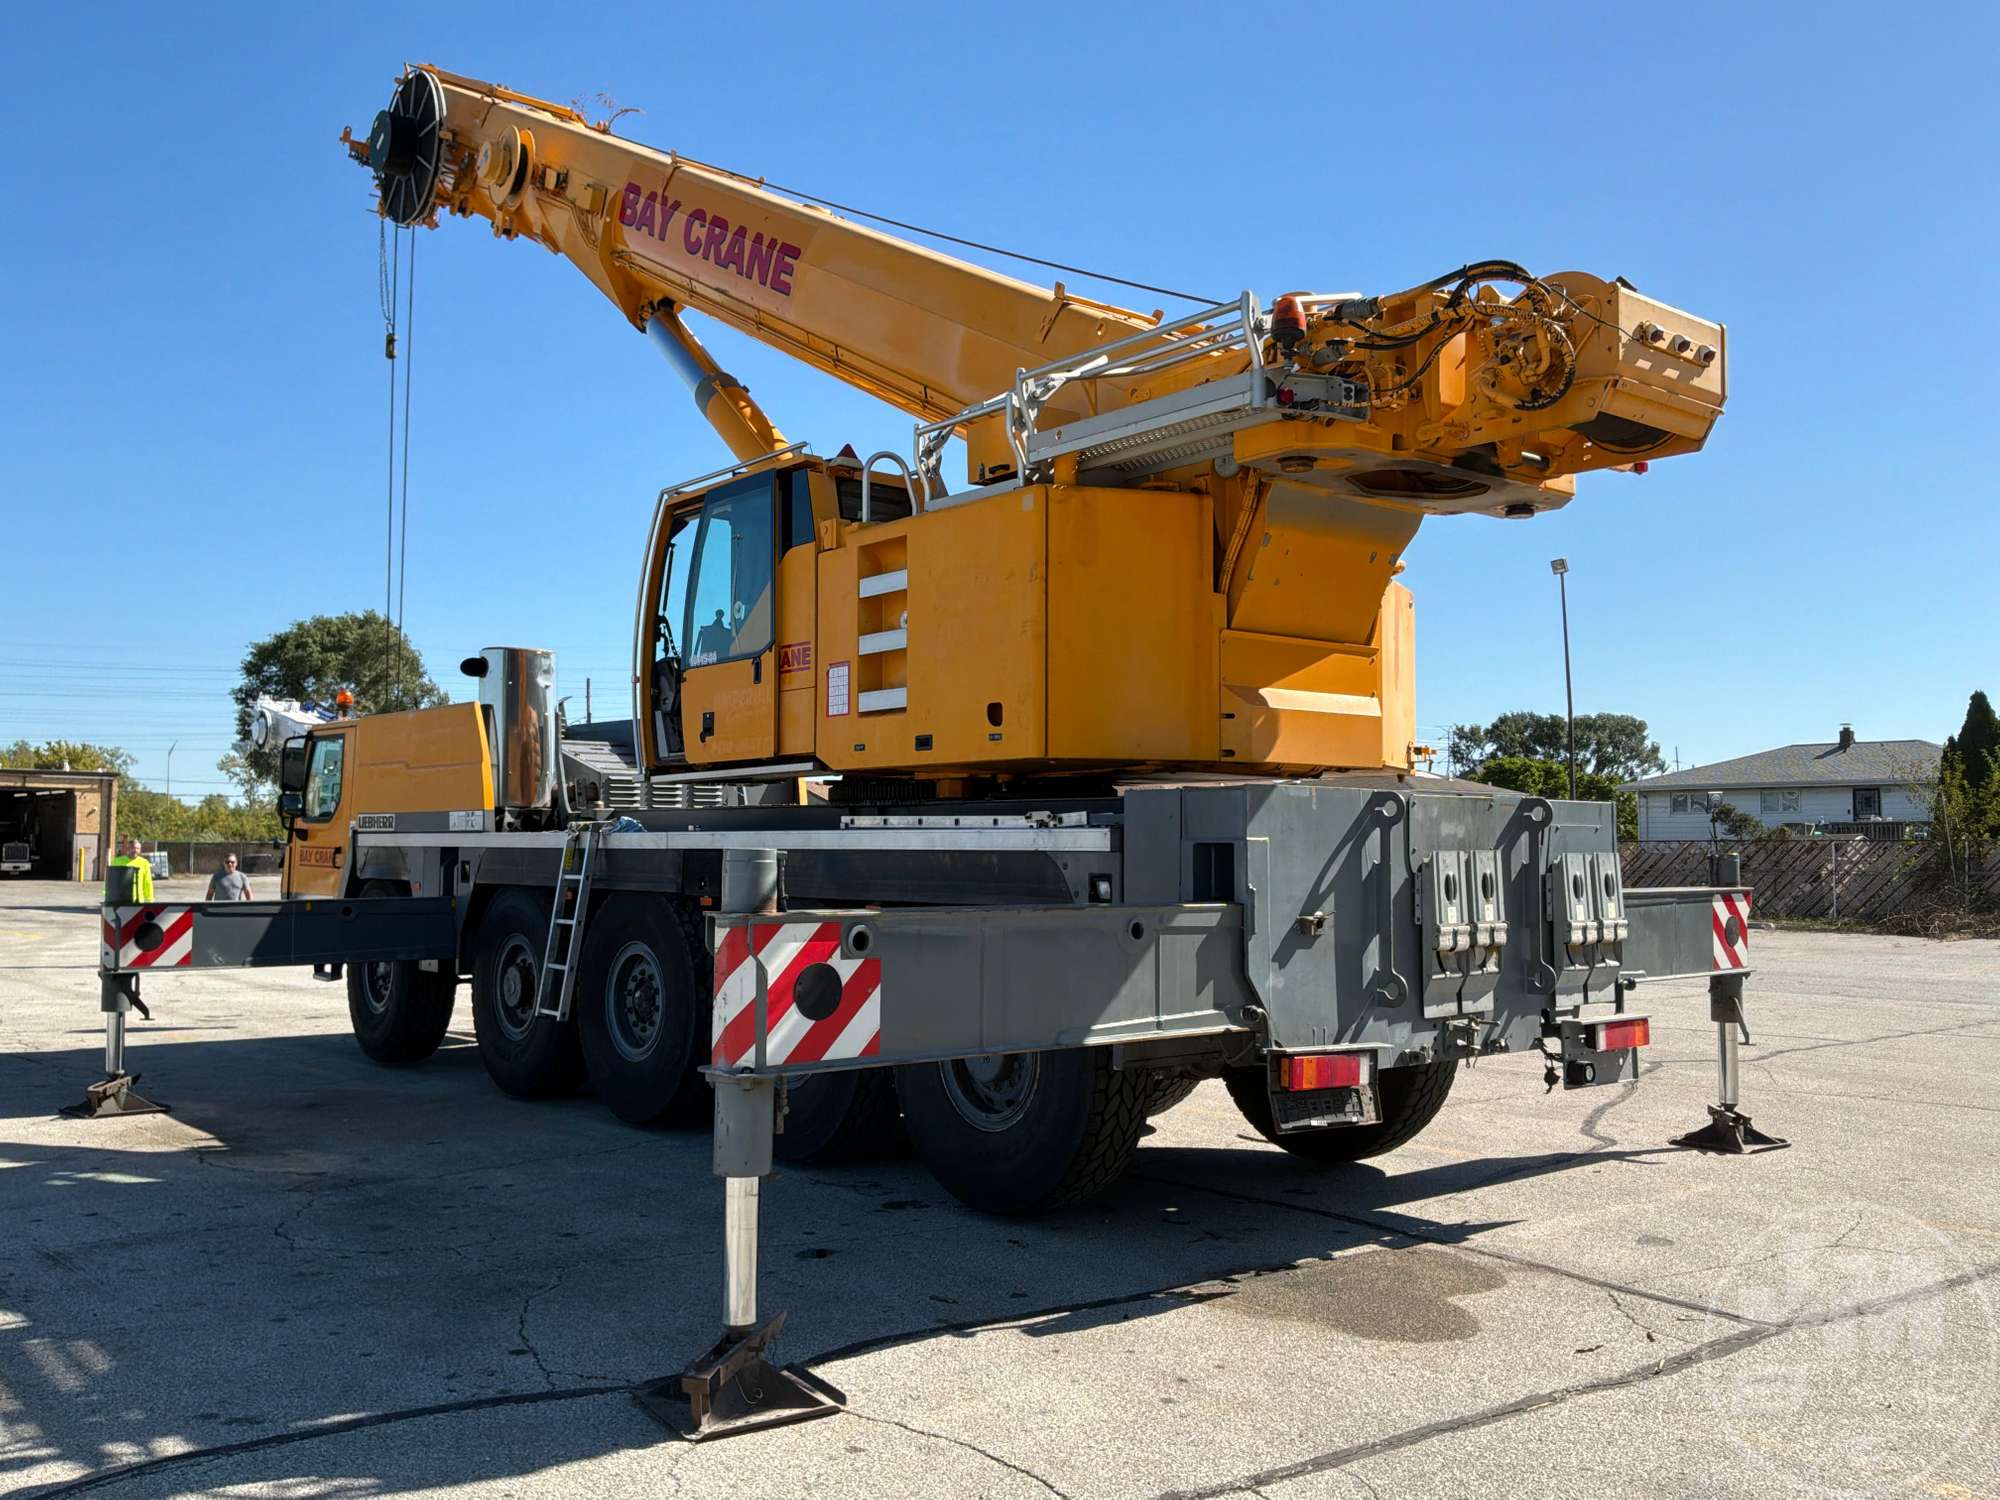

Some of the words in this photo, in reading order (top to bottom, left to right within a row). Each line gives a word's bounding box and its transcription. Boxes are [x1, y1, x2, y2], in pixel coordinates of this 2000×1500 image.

[619, 181, 682, 241] BAY
[684, 208, 801, 296] CRANE
[781, 646, 811, 668] ANE
[358, 815, 394, 829] LIEBHERR
